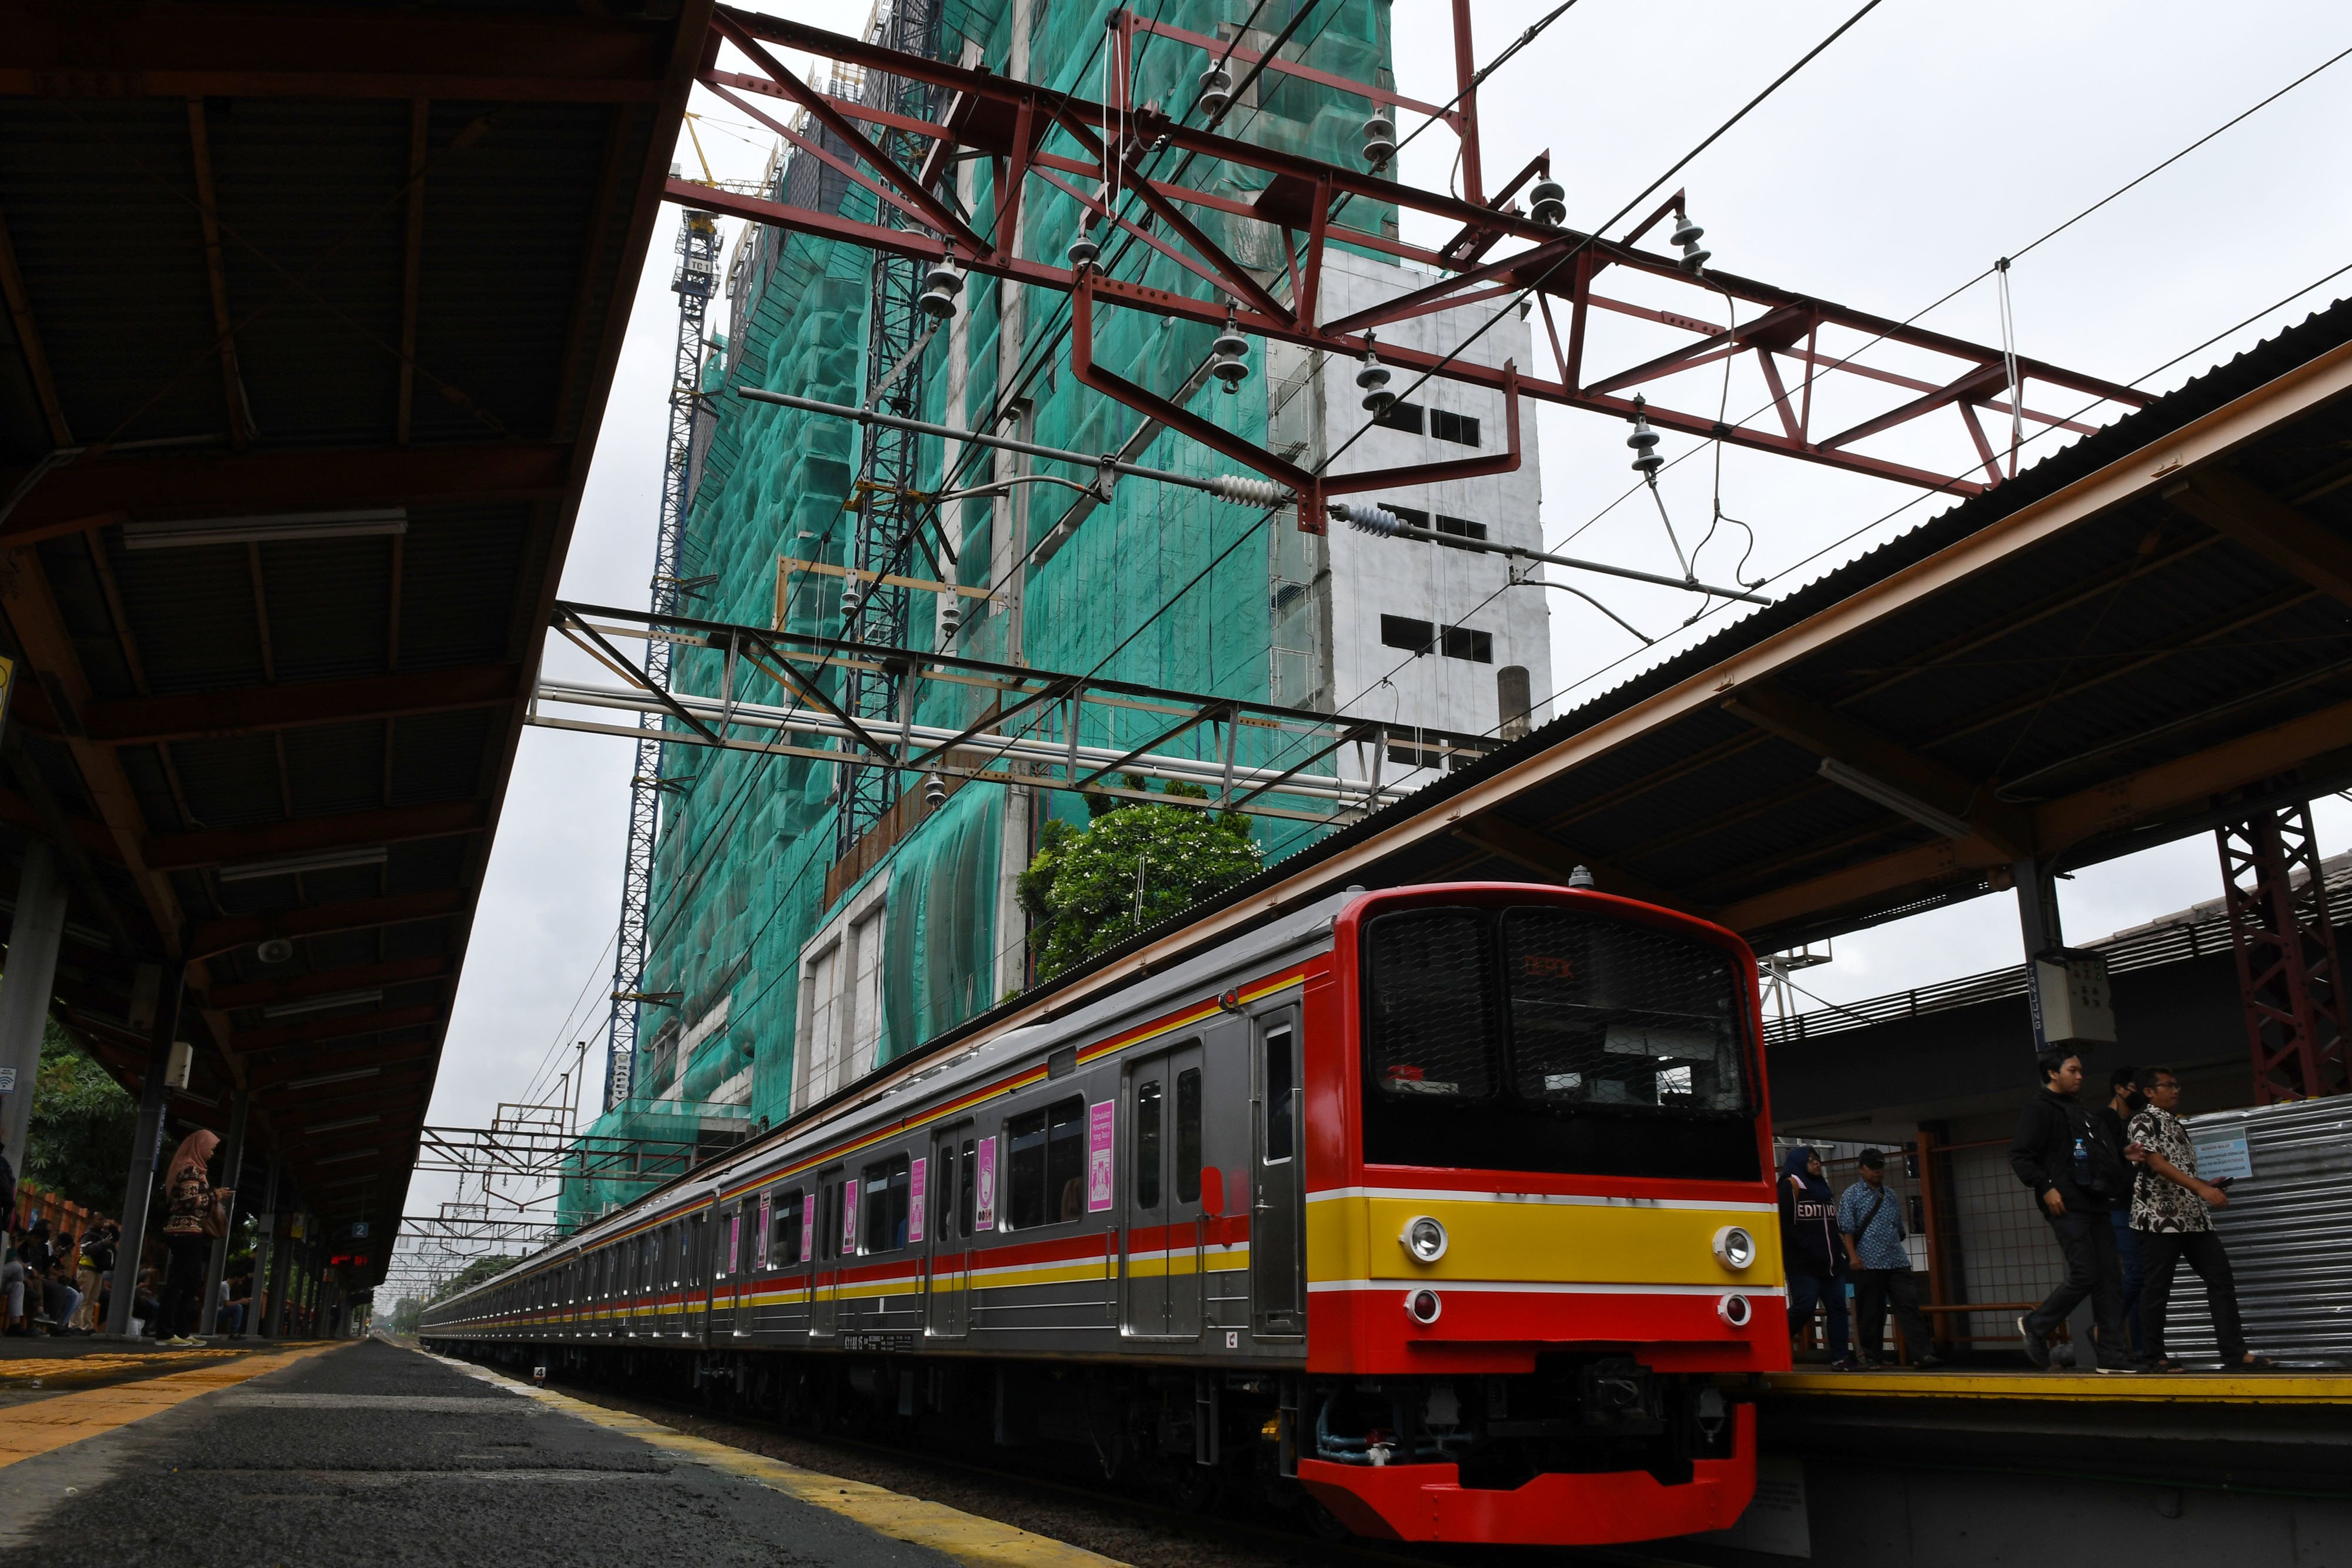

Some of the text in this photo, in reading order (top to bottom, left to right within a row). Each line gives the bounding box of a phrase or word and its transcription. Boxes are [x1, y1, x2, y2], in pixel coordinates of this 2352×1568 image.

[691, 261, 709, 272] TC 1
[1525, 955, 1575, 979] DEPOK
[2028, 967, 2042, 1029] TANJUNG
[614, 1065, 627, 1101] SAFETY
[1798, 1204, 1835, 1217] EDITIO
[356, 1225, 365, 1235] 2
[536, 1368, 544, 1377] 4
